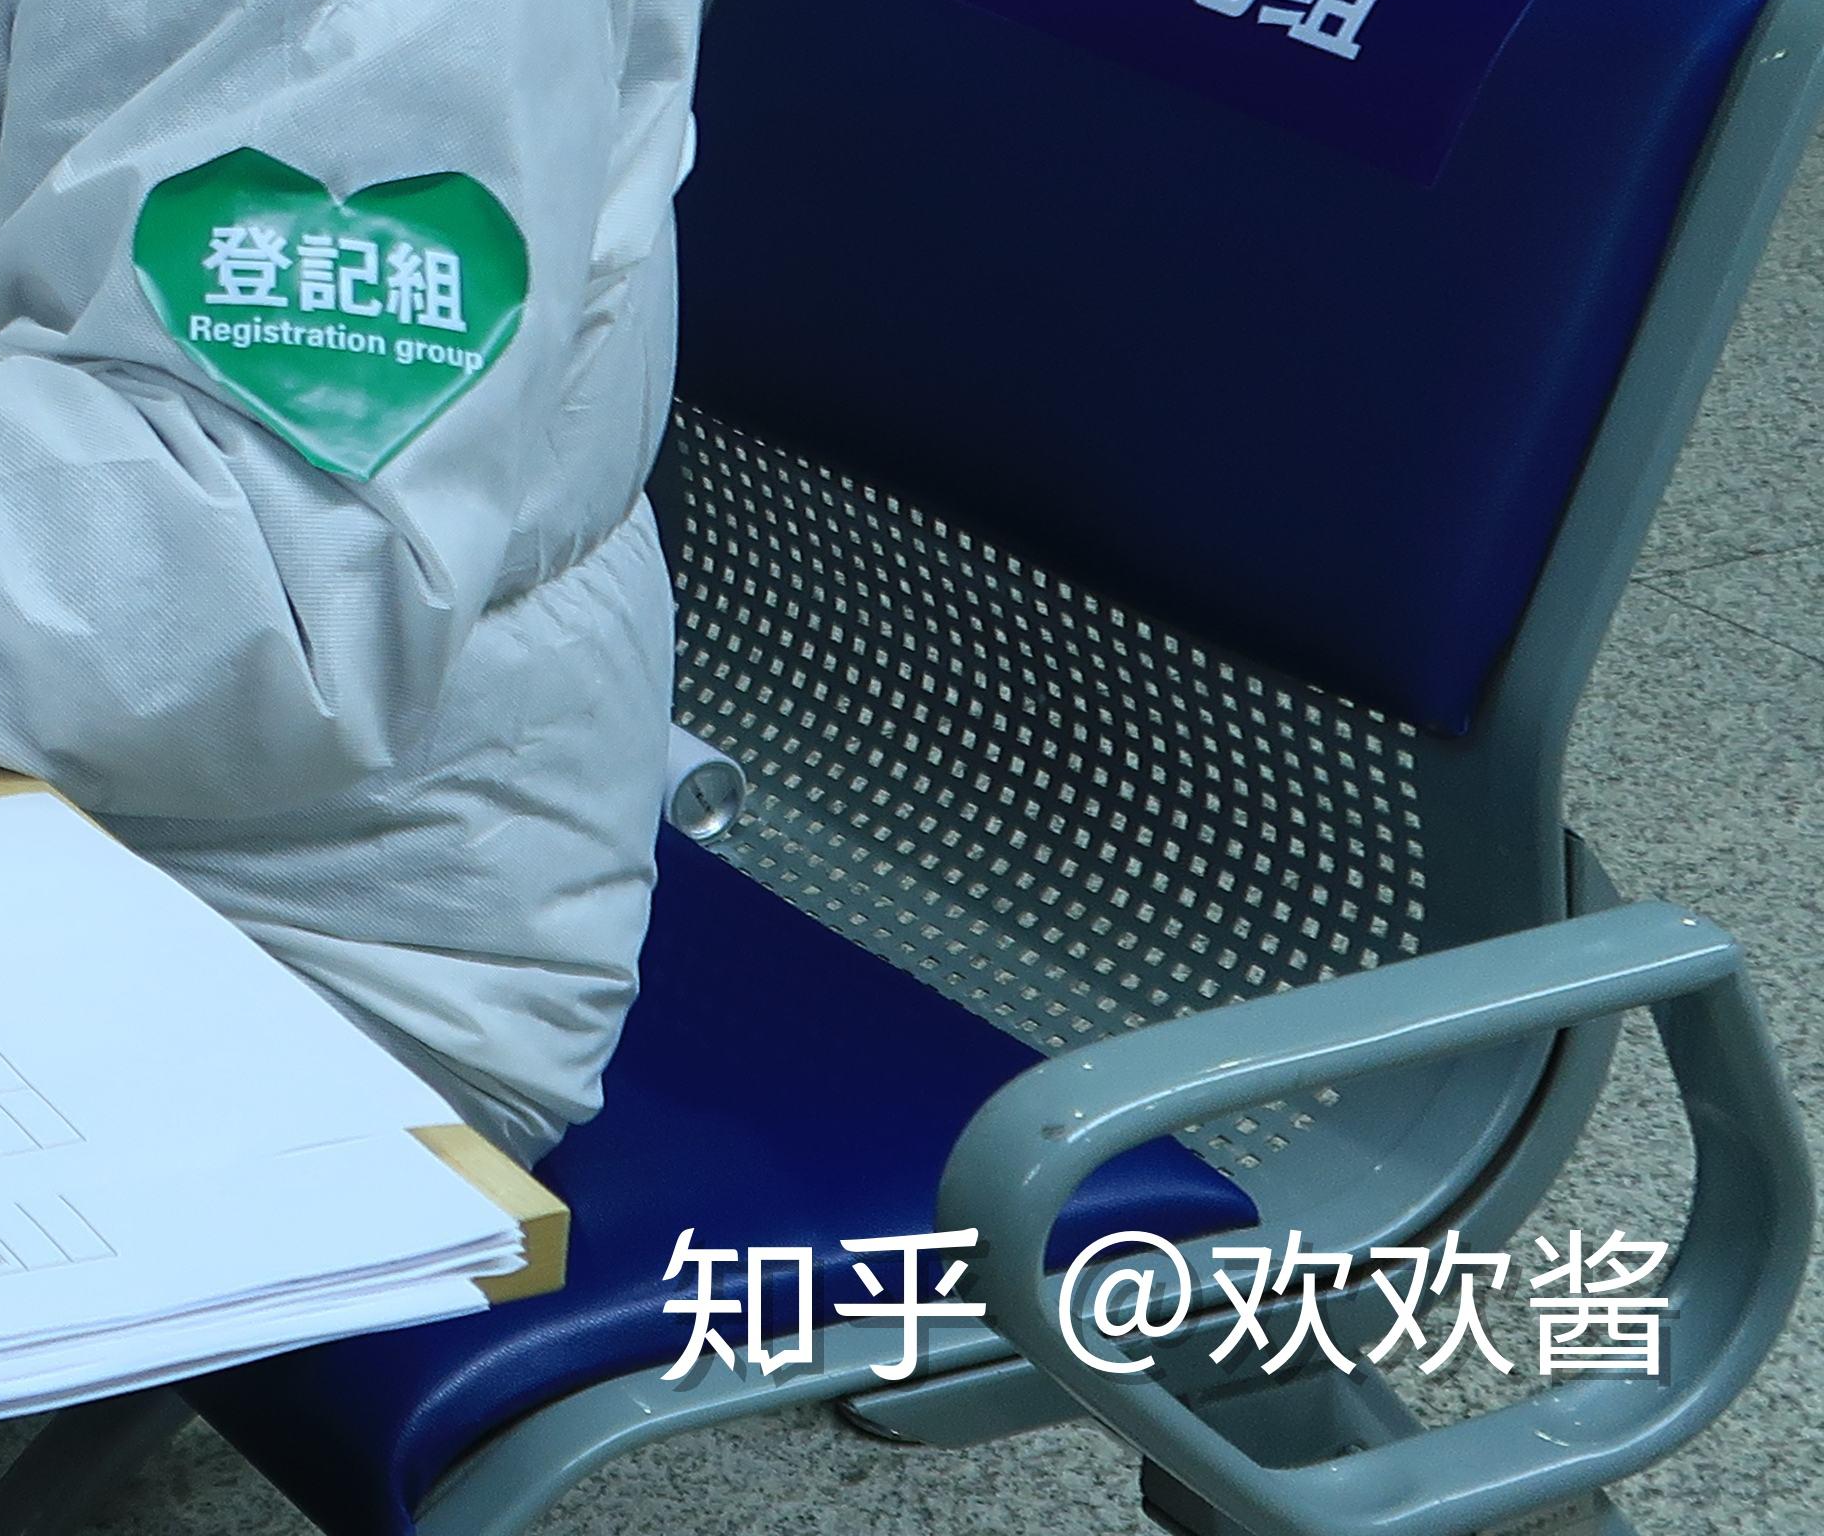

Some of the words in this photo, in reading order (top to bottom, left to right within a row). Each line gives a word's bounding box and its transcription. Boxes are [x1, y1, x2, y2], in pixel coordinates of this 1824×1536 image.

[202, 226, 468, 334] 登記組
[188, 314, 386, 357] Registration
[393, 335, 485, 377] group
